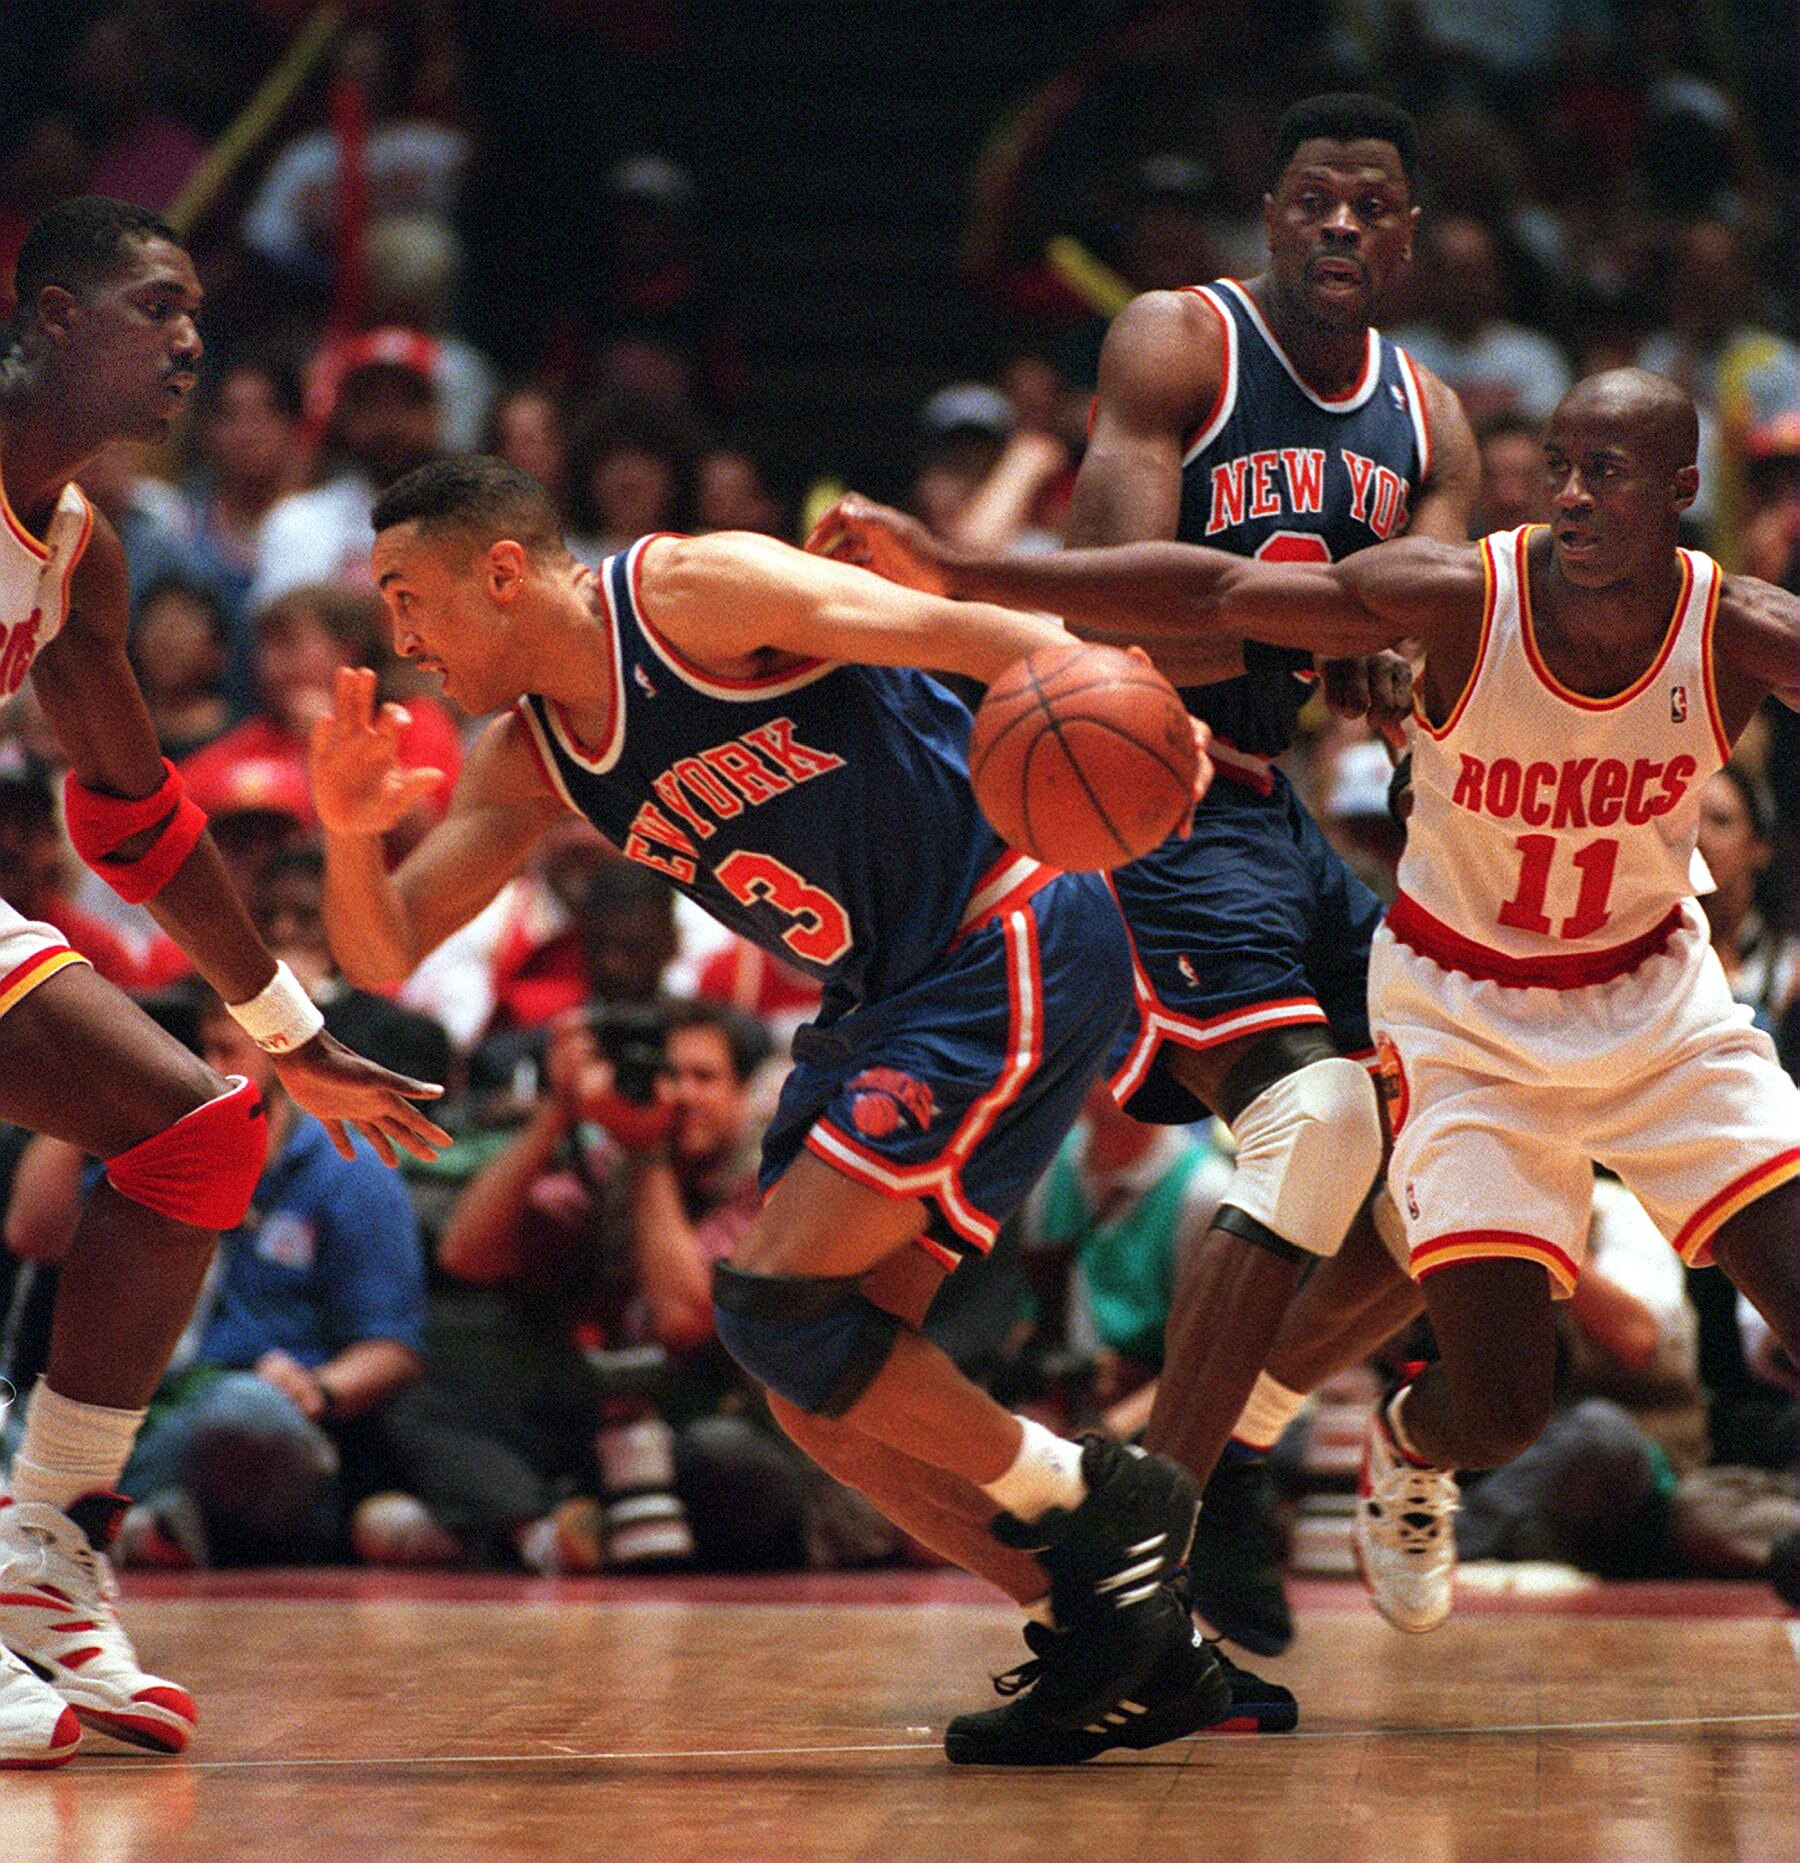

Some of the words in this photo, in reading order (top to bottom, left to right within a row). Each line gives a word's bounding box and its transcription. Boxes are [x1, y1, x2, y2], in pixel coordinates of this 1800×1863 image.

[1205, 447, 1326, 537] NEW
[651, 716, 848, 840] YORK
[712, 849, 854, 966] 3
[1497, 833, 1620, 940] 11
